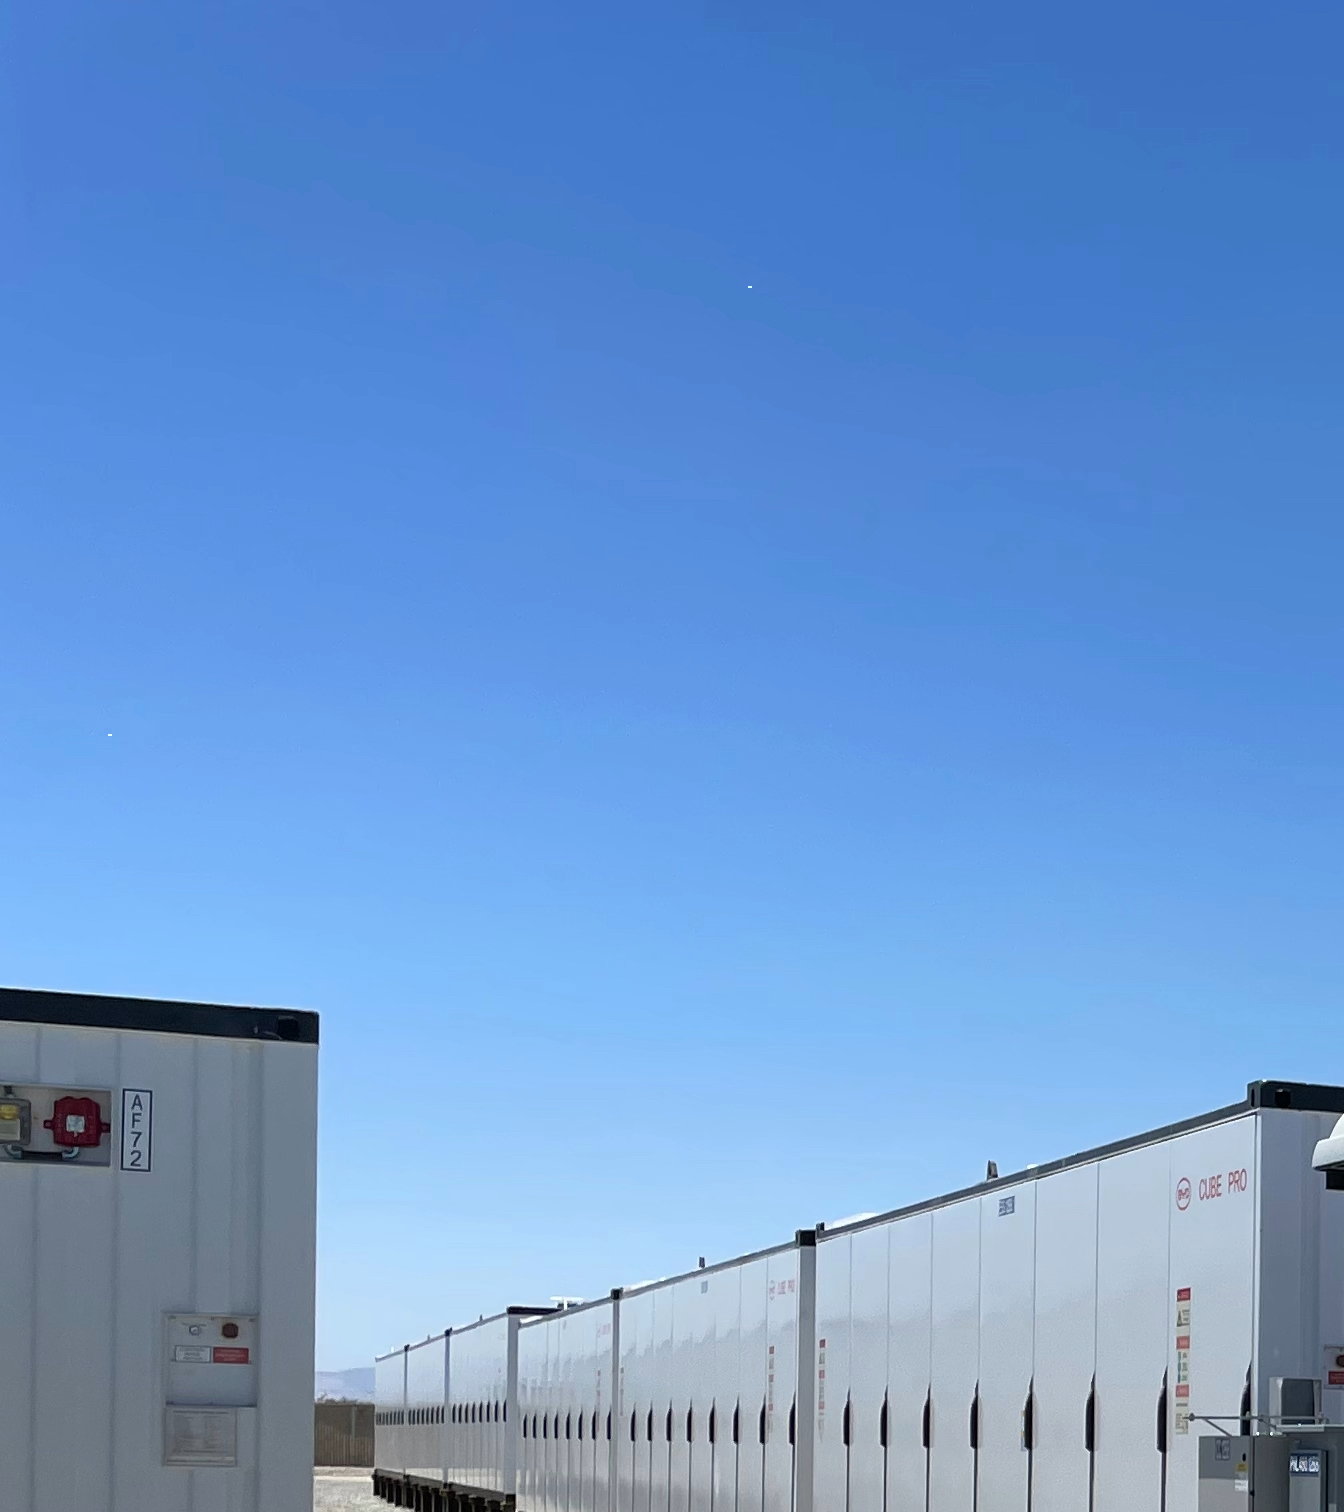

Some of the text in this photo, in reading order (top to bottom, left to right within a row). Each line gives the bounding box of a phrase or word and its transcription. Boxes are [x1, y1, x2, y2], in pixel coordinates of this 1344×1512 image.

[130, 1093, 144, 1167] AF72
[1198, 1174, 1222, 1201] CUBE
[1227, 1168, 1247, 1194] PRO
